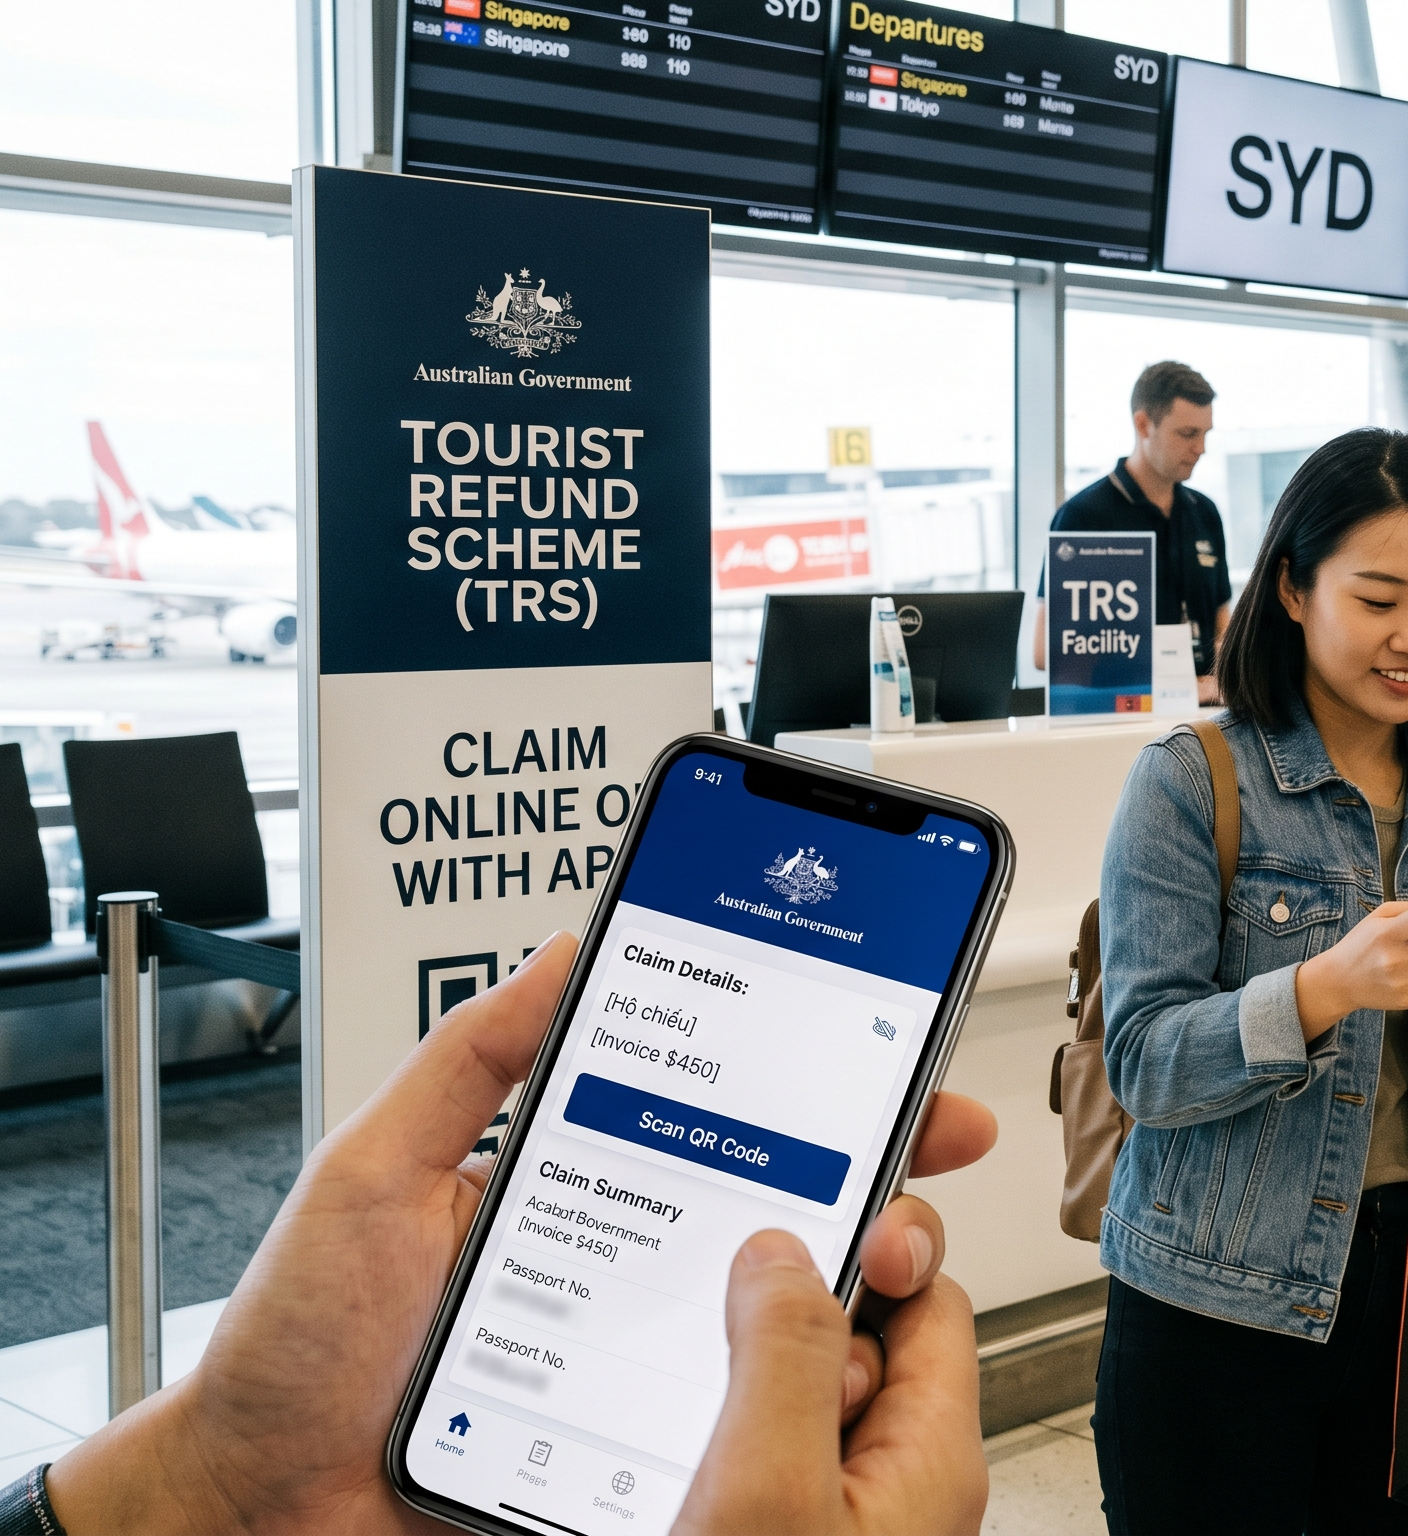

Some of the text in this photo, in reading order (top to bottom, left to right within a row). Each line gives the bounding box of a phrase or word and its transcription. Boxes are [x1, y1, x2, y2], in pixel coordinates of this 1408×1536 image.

[485, 1, 570, 31] Singapore
[765, 0, 821, 22] SYD
[850, 2, 984, 52] Departures
[485, 28, 570, 58] Singapore
[901, 71, 968, 97] Singapore
[1114, 55, 1159, 86] SYD
[900, 94, 940, 118] Tokyo
[1226, 135, 1374, 232] SYD
[413, 363, 633, 392] Australian Government
[401, 419, 644, 470] TOURIST
[411, 473, 639, 520] REFUND
[407, 526, 641, 571] SCHEME
[456, 577, 598, 632] (TRS)
[1062, 580, 1139, 622] TRS
[1062, 629, 1140, 659] Facility
[443, 725, 607, 778] CLAIM
[694, 768, 723, 786] 9:41
[380, 783, 641, 845] ONLINE O
[392, 845, 614, 908] WITH AP
[714, 892, 864, 945] Australian Government
[623, 944, 749, 996] Claim Details:
[604, 992, 698, 1037] [Hộ chiếu]
[590, 1027, 721, 1084] [Invoice $450]
[638, 1111, 770, 1167] Scan QR Code
[539, 1160, 683, 1223] Claim Summary
[517, 1215, 619, 1263] [Invoice $450]
[575, 1211, 661, 1251] Bovernment
[502, 1258, 592, 1301] Passport No.
[476, 1327, 567, 1371] Passport No.
[434, 1438, 465, 1457] Home
[592, 1496, 636, 1521] Settings
